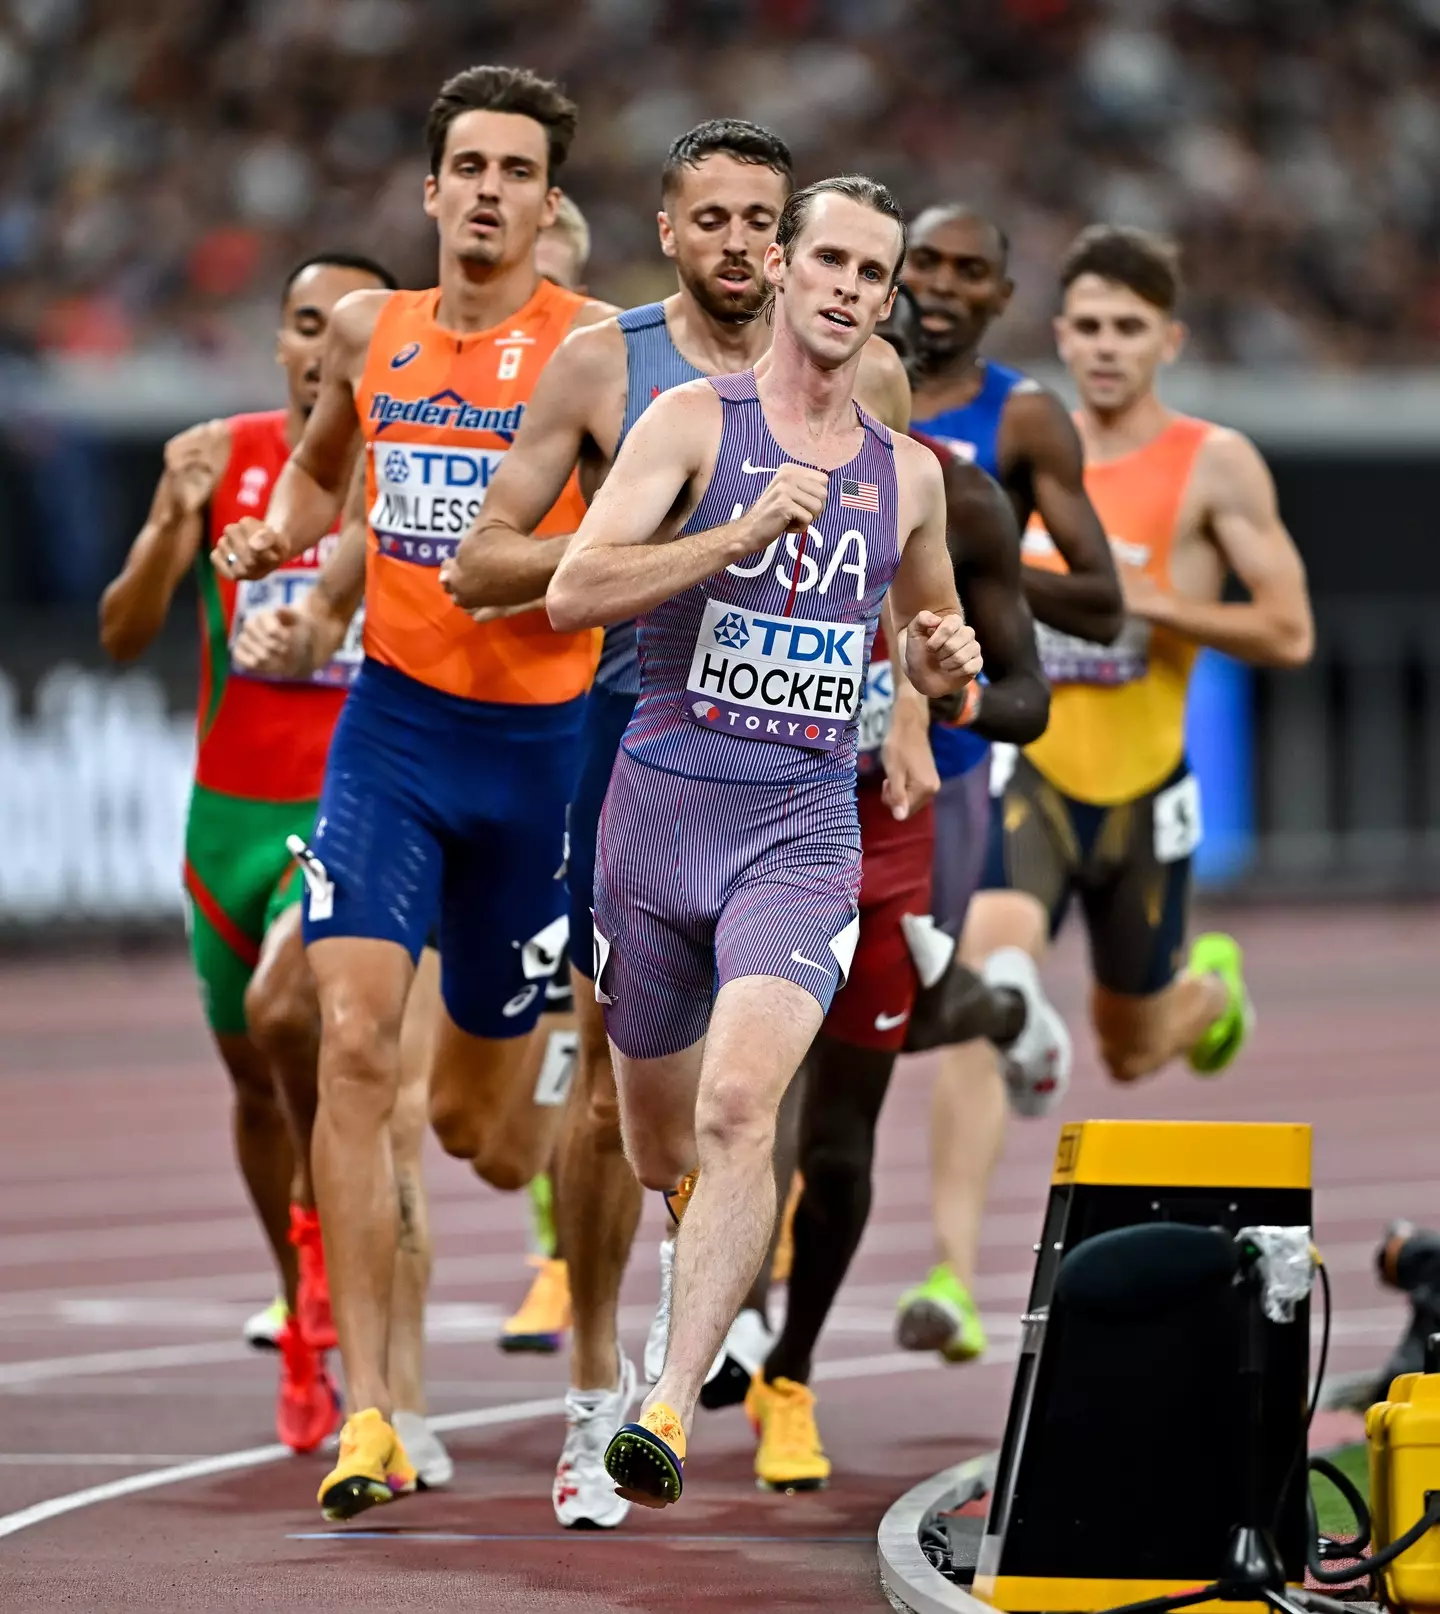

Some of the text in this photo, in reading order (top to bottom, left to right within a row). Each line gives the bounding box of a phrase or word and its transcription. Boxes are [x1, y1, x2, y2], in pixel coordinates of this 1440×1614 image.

[370, 393, 526, 432] Nederland
[726, 503, 868, 601] USA
[752, 618, 855, 666] TDK
[699, 653, 855, 714] HOCKER
